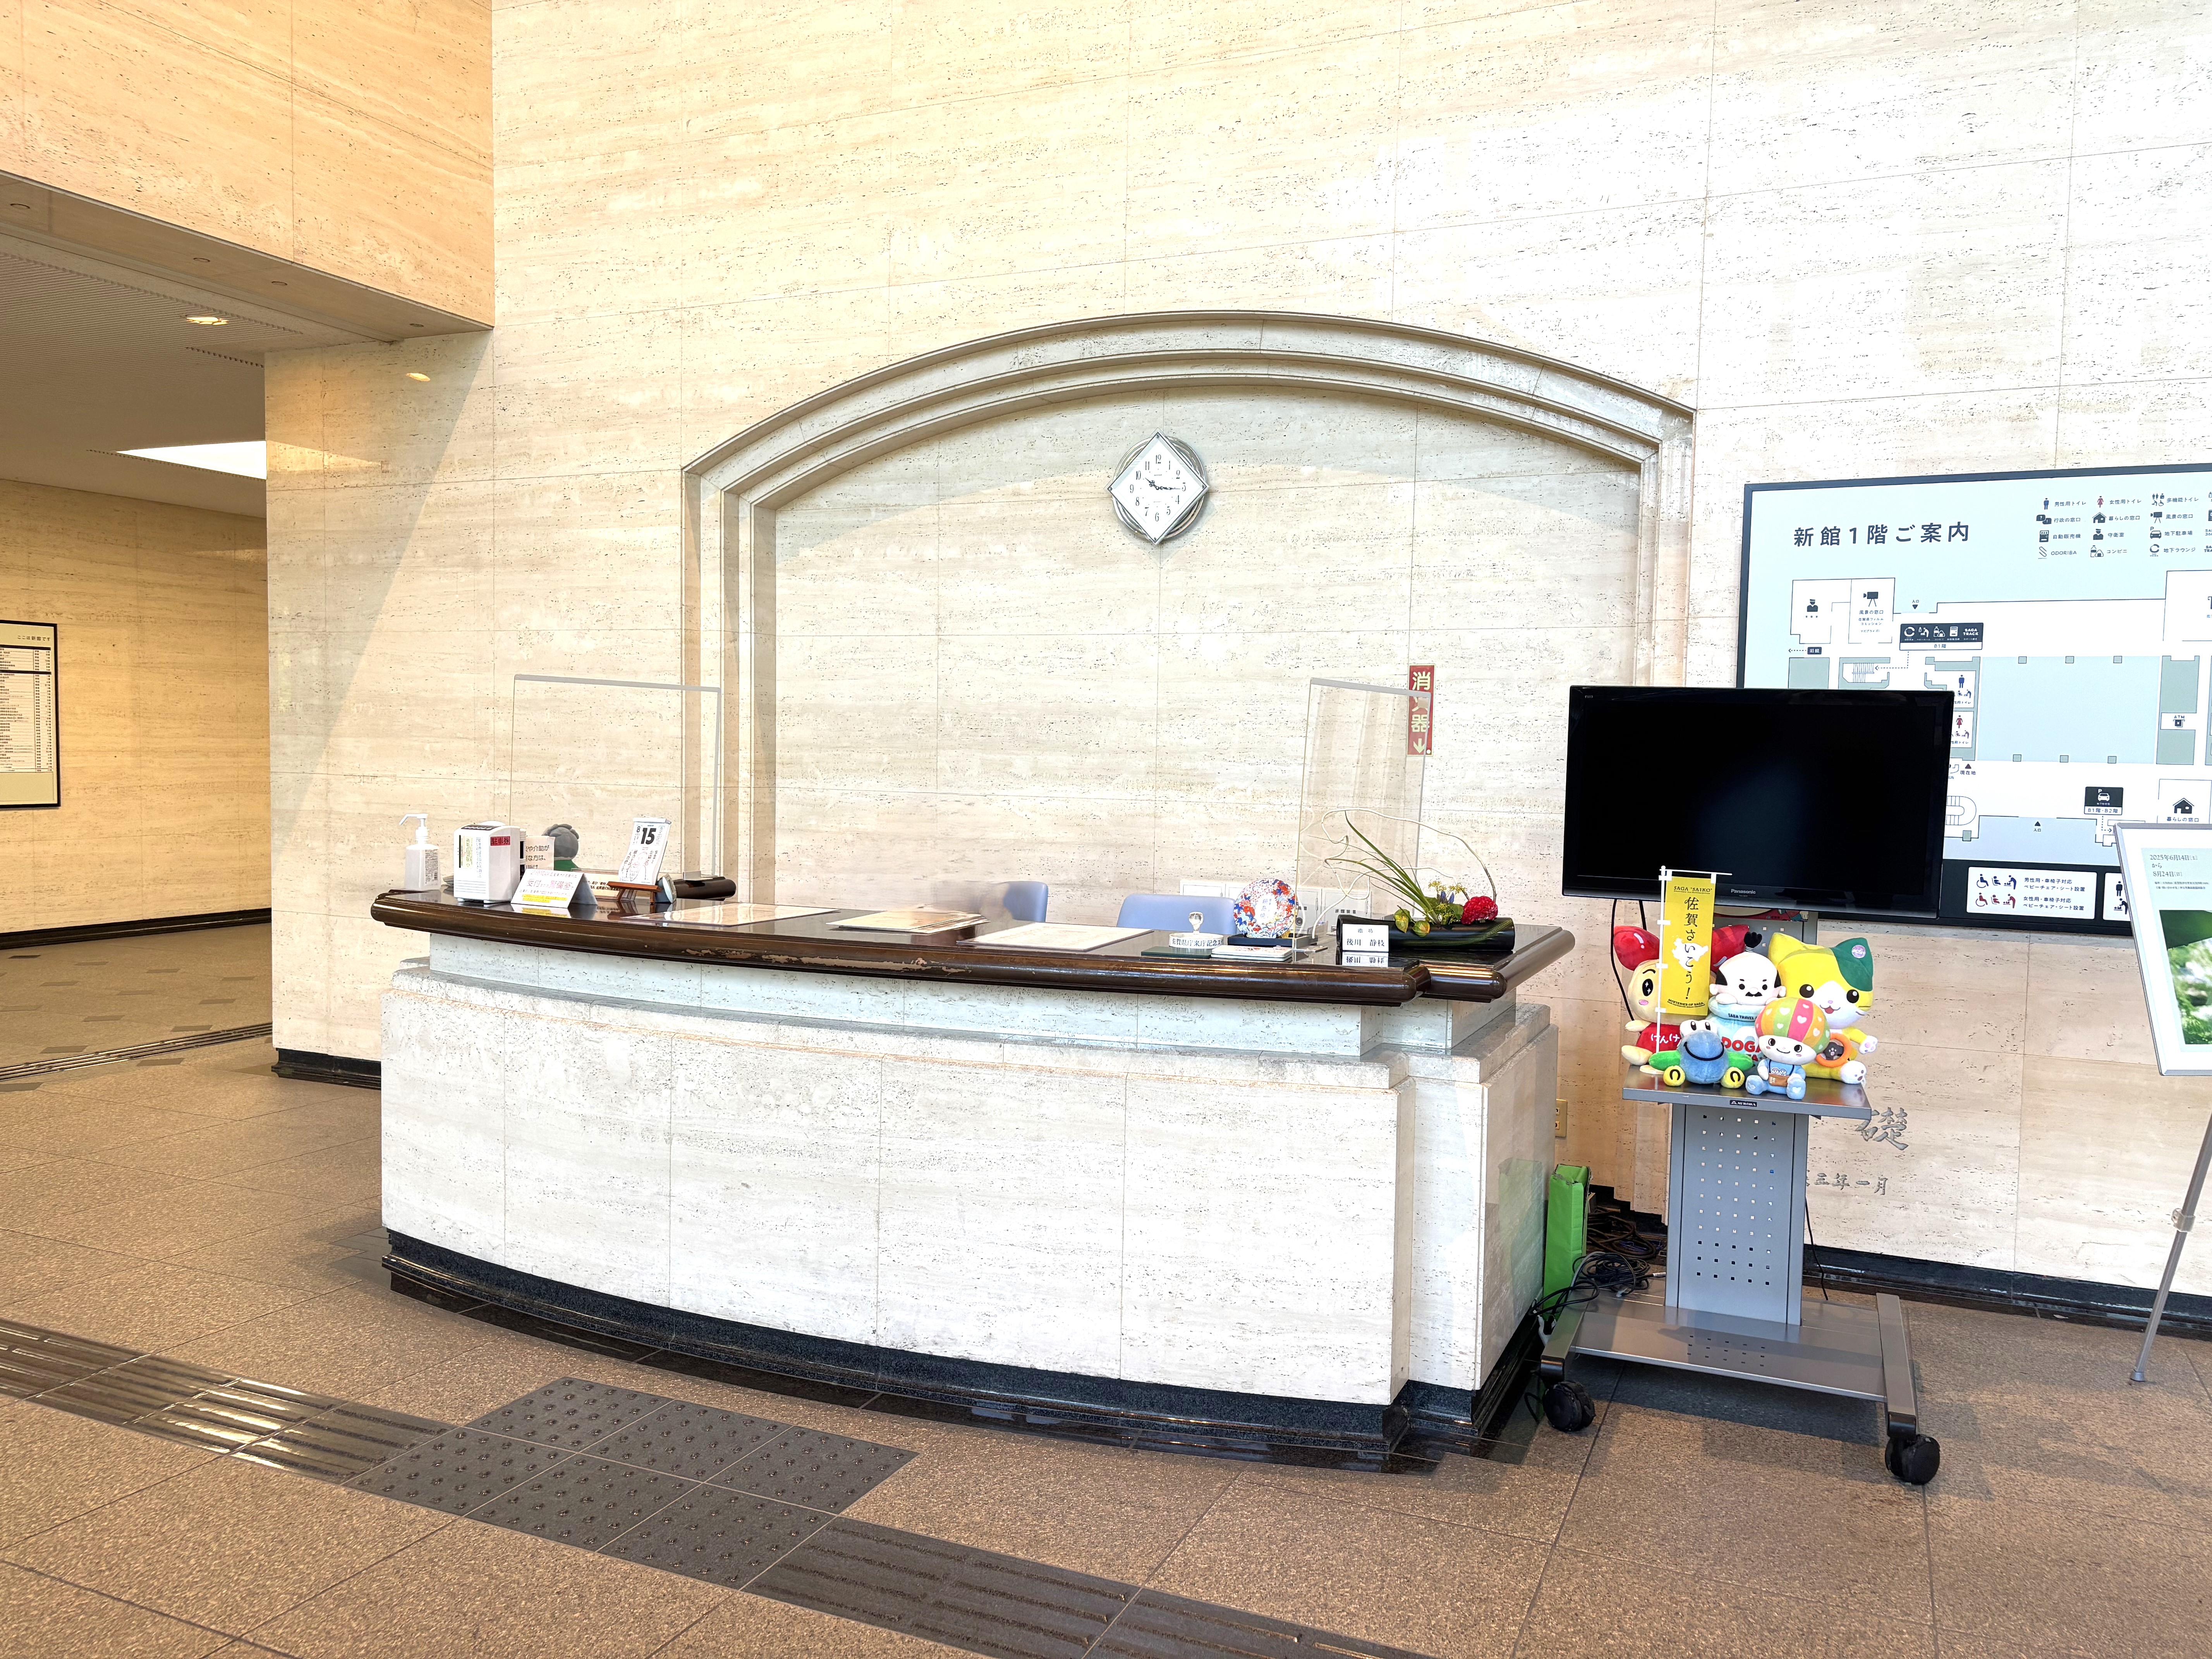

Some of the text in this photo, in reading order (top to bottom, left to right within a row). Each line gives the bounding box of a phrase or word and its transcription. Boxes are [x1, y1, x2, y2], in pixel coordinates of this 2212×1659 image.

[1156, 454, 1161, 464] 12
[1145, 461, 1149, 470] 11
[1136, 471, 1141, 479] 10
[1176, 470, 1180, 479] 2
[1130, 484, 1134, 493] 9
[1182, 483, 1186, 491] 3
[1135, 497, 1140, 506] 8
[1175, 495, 1180, 504] 4
[1145, 507, 1149, 516] 7
[1166, 506, 1171, 515] 5
[1155, 512, 1159, 522] 6
[1794, 521, 1968, 547] 新館1階ご案内
[641, 828, 656, 845] 15
[1651, 1033, 1681, 1046] けんけ
[1807, 1170, 1888, 1195] 三年一月
